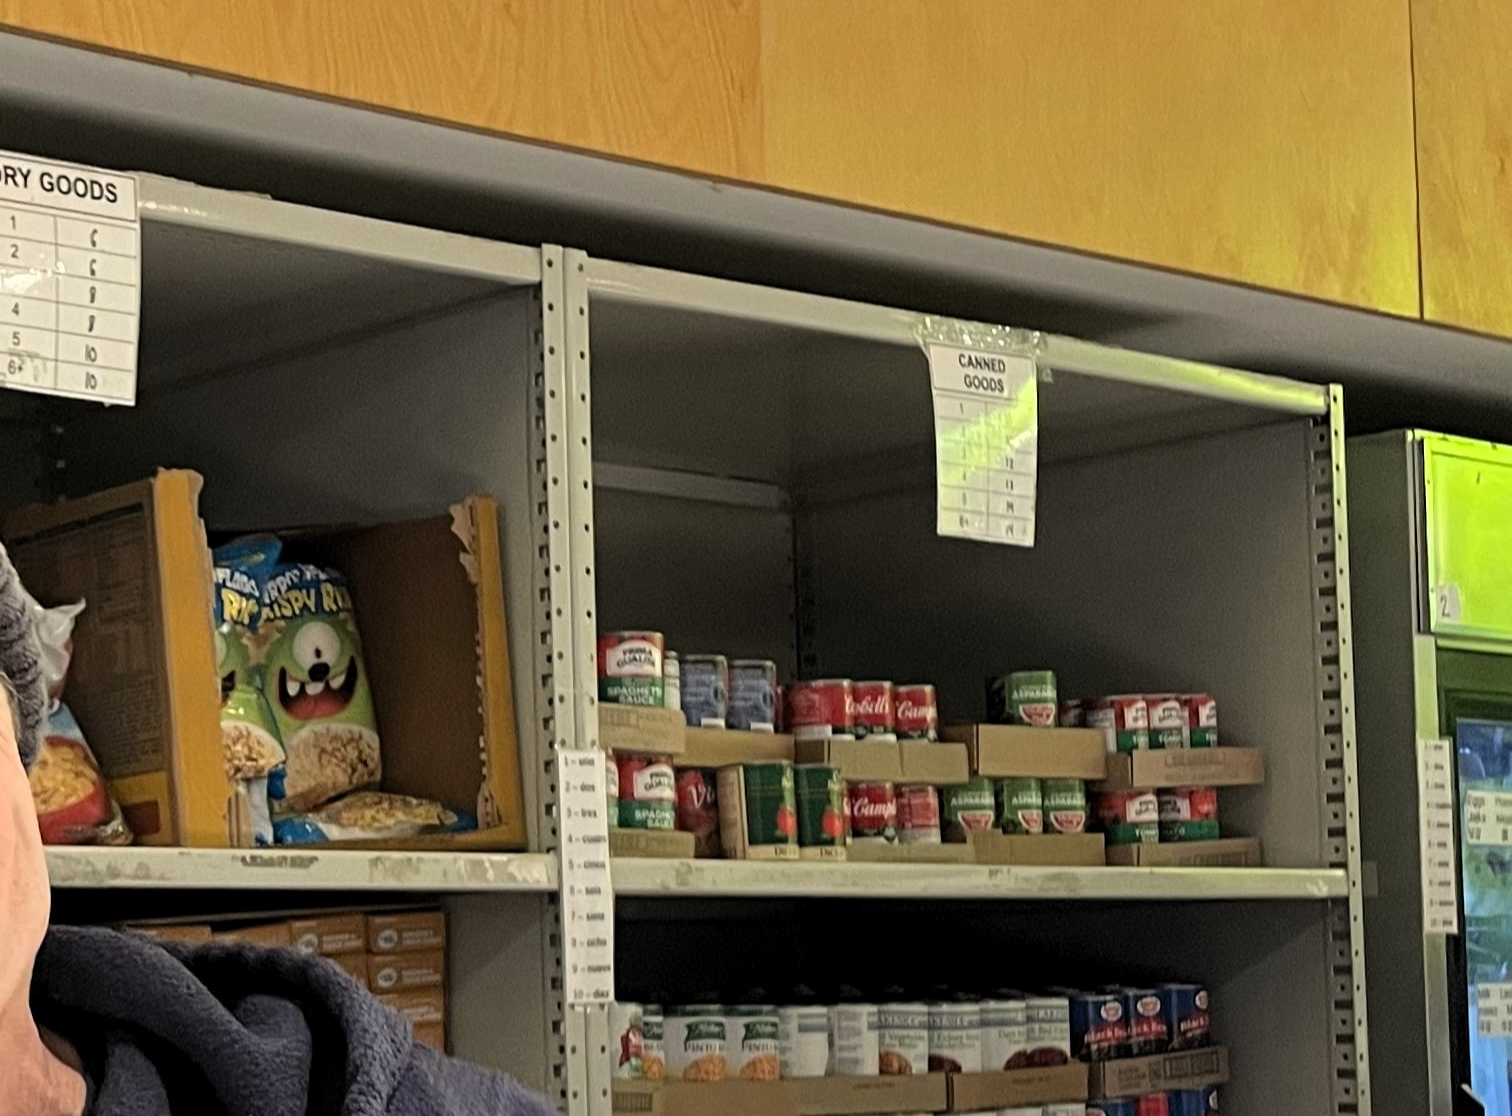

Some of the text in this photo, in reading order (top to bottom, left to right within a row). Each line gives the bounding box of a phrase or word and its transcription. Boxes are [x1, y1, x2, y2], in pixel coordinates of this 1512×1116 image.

[39, 171, 118, 204] GOODS
[9, 215, 17, 230] 1
[10, 244, 19, 259] 2
[11, 303, 20, 316] 4
[12, 331, 97, 363] 5 10
[958, 353, 1006, 374] CANNED
[84, 373, 97, 390] 10
[964, 373, 1004, 393] GOODS
[1440, 594, 1451, 618] 2
